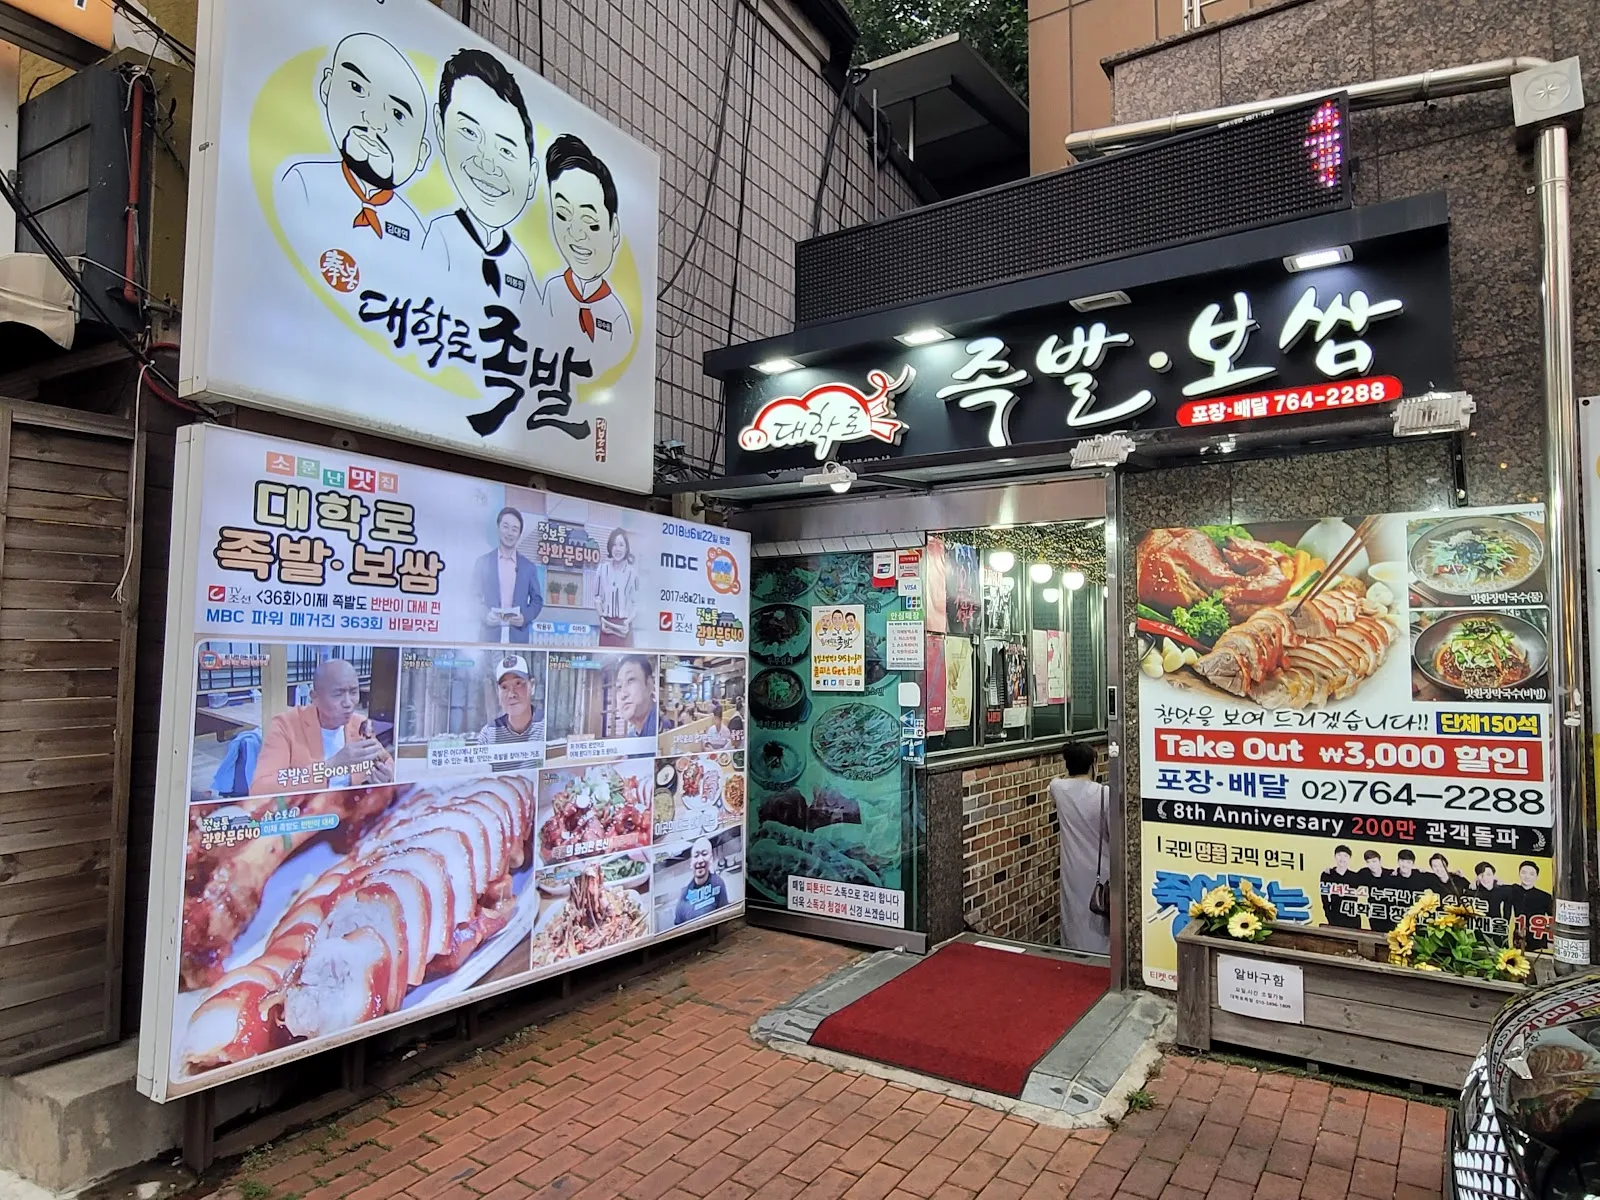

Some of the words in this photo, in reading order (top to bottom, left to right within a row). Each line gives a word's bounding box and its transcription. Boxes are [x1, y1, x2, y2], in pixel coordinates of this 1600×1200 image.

[358, 290, 477, 368] 대학로
[467, 305, 593, 440] 족발
[1191, 398, 1269, 423] 포장·배달
[1274, 382, 1386, 413] 764-2288
[773, 401, 866, 459] 대학로
[254, 480, 418, 545] 대학로
[537, 522, 567, 544] 정보통
[213, 526, 445, 595] 족발·보쌈
[537, 541, 601, 567] 광화문640
[660, 552, 699, 571] MBC
[228, 594, 251, 604] 조선
[229, 587, 242, 595] TV
[332, 594, 367, 611] 족발도
[371, 597, 403, 613] 반반이
[406, 599, 428, 614] 대세
[431, 601, 440, 615] 편
[206, 609, 245, 624] MBC
[251, 610, 283, 626] 파워
[290, 613, 335, 628] 매거진
[340, 615, 383, 630] 363회
[388, 617, 439, 632] 비밀맛집
[674, 621, 693, 633] 조선
[675, 612, 686, 622] TV
[832, 665, 846, 676] Get
[1155, 704, 1215, 726] 참맛을
[1222, 709, 1265, 727] 보여
[1273, 709, 1429, 732] 드리겠습니다!!
[1440, 713, 1539, 736] 단체150석
[1160, 734, 1235, 759] Take
[1243, 737, 1304, 763] Out
[1318, 741, 1445, 770] ₩3,000
[1453, 745, 1529, 775] 할인
[277, 767, 311, 787] 족발은
[312, 762, 349, 784] 뜯어야
[350, 760, 375, 776] 제맛
[1156, 768, 1289, 800] 포장·배달
[1173, 802, 1206, 820] 8th
[1213, 805, 1344, 839] Anniversary
[1351, 816, 1417, 841] 200만
[1425, 822, 1520, 850] 관객돌파
[201, 827, 261, 850] 광화문640
[1165, 839, 1192, 858] 국민
[1195, 840, 1227, 864] 명품
[1231, 846, 1259, 866] 코믹
[1264, 849, 1295, 870] 연극
[792, 880, 805, 892] 매일
[806, 882, 833, 895] 피톤치드
[834, 886, 861, 900] 소독으로
[863, 890, 876, 903] 관리
[878, 892, 899, 907] 합니다
[1371, 887, 1411, 904] 누구나
[792, 896, 805, 908] 더욱
[806, 898, 826, 911] 소독과
[827, 900, 847, 915] 청결에
[849, 904, 863, 917] 신경
[864, 906, 900, 924] 쓰겠습니다
[1340, 901, 1387, 919] 대학로
[1150, 970, 1166, 982] 티켓
[1234, 968, 1285, 988] 알바구함
